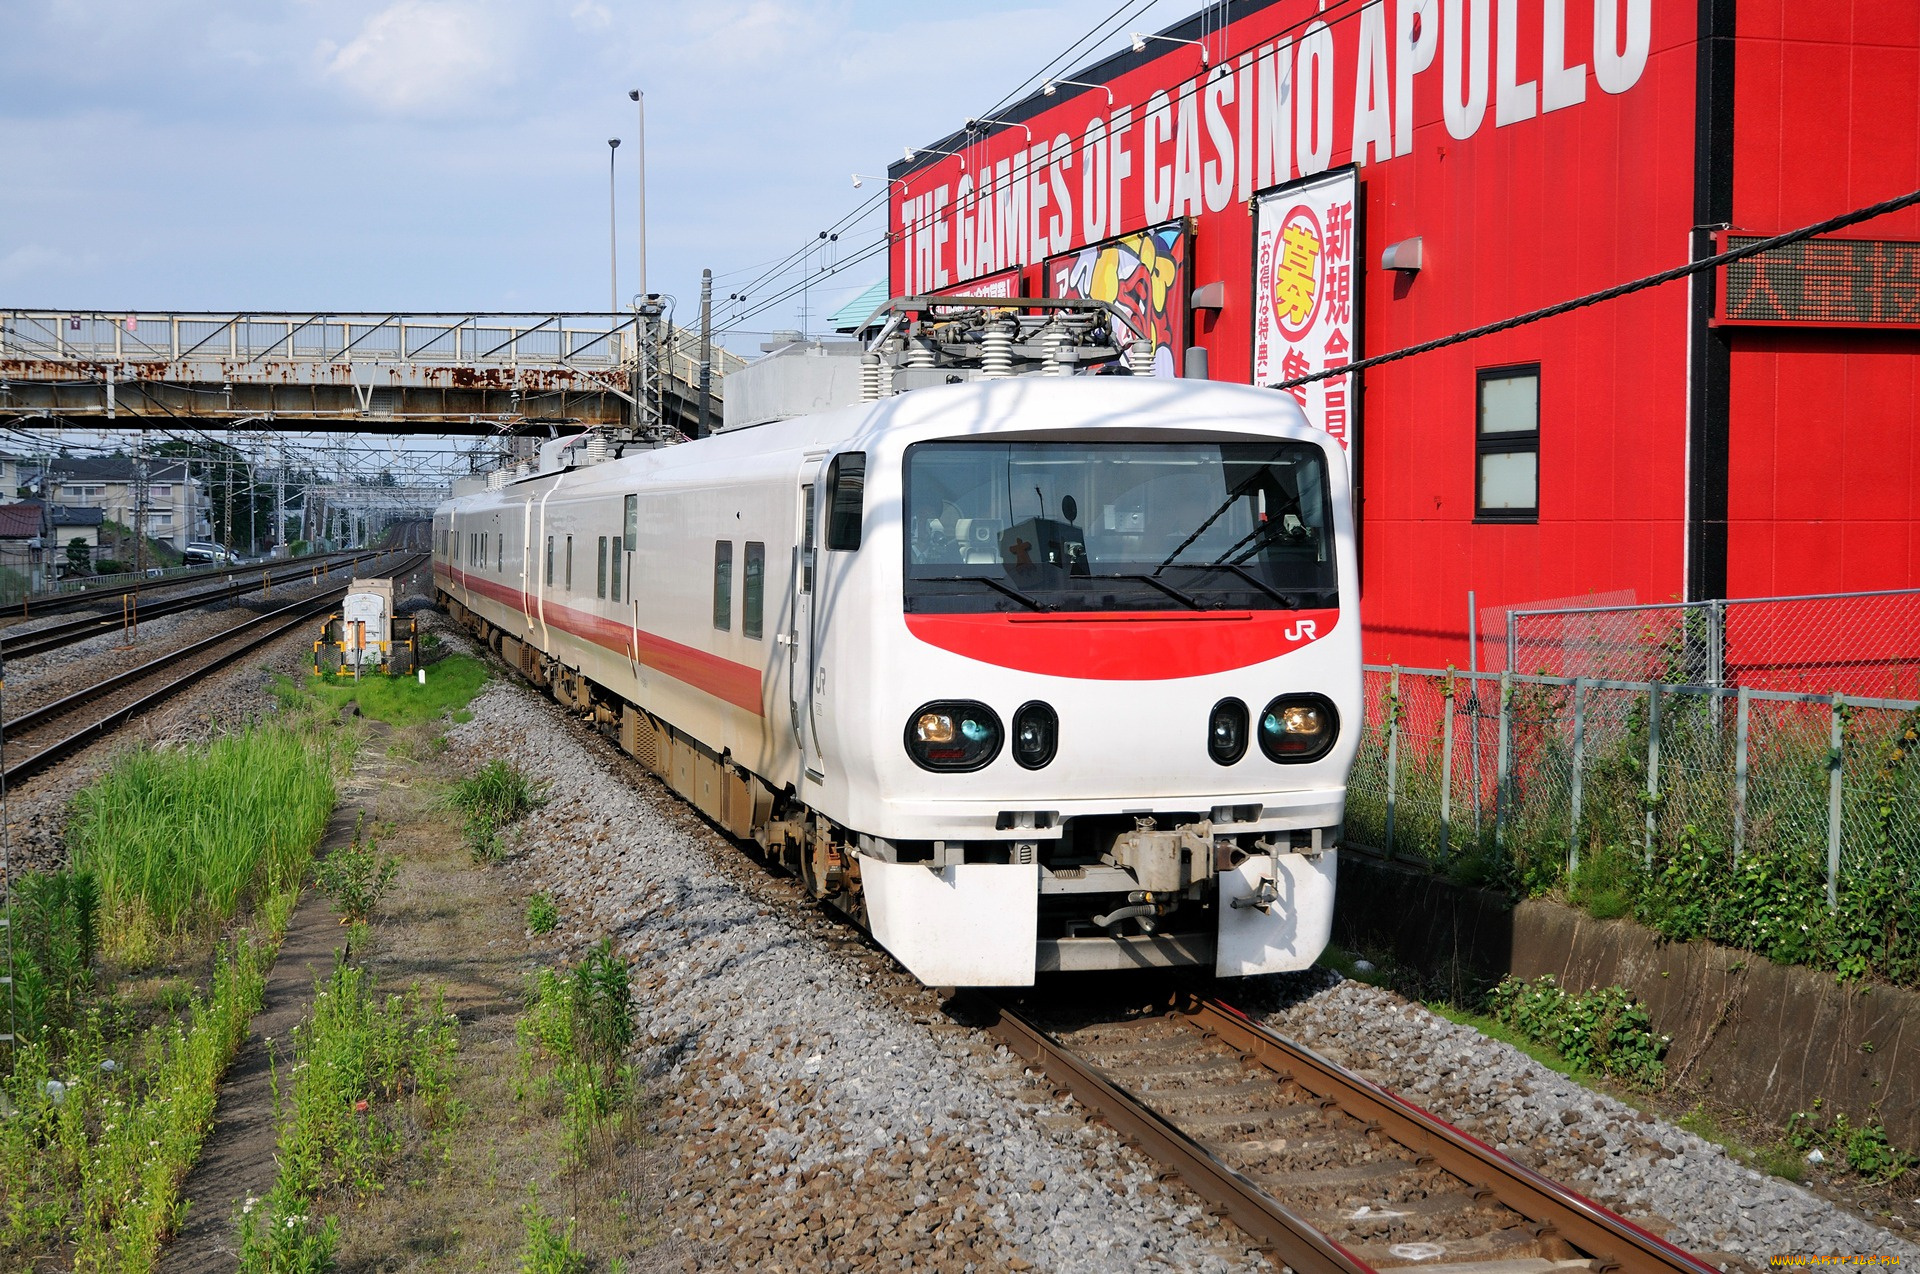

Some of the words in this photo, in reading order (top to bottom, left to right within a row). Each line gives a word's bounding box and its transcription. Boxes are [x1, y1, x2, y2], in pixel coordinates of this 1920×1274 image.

[902, 183, 949, 296] THE
[956, 133, 1073, 284] GAMES
[1083, 105, 1131, 243] OF
[1144, 20, 1335, 226] CASINO
[1323, 200, 1352, 451] 新規会員
[816, 666, 826, 696] JR
[1284, 620, 1317, 641] JR
